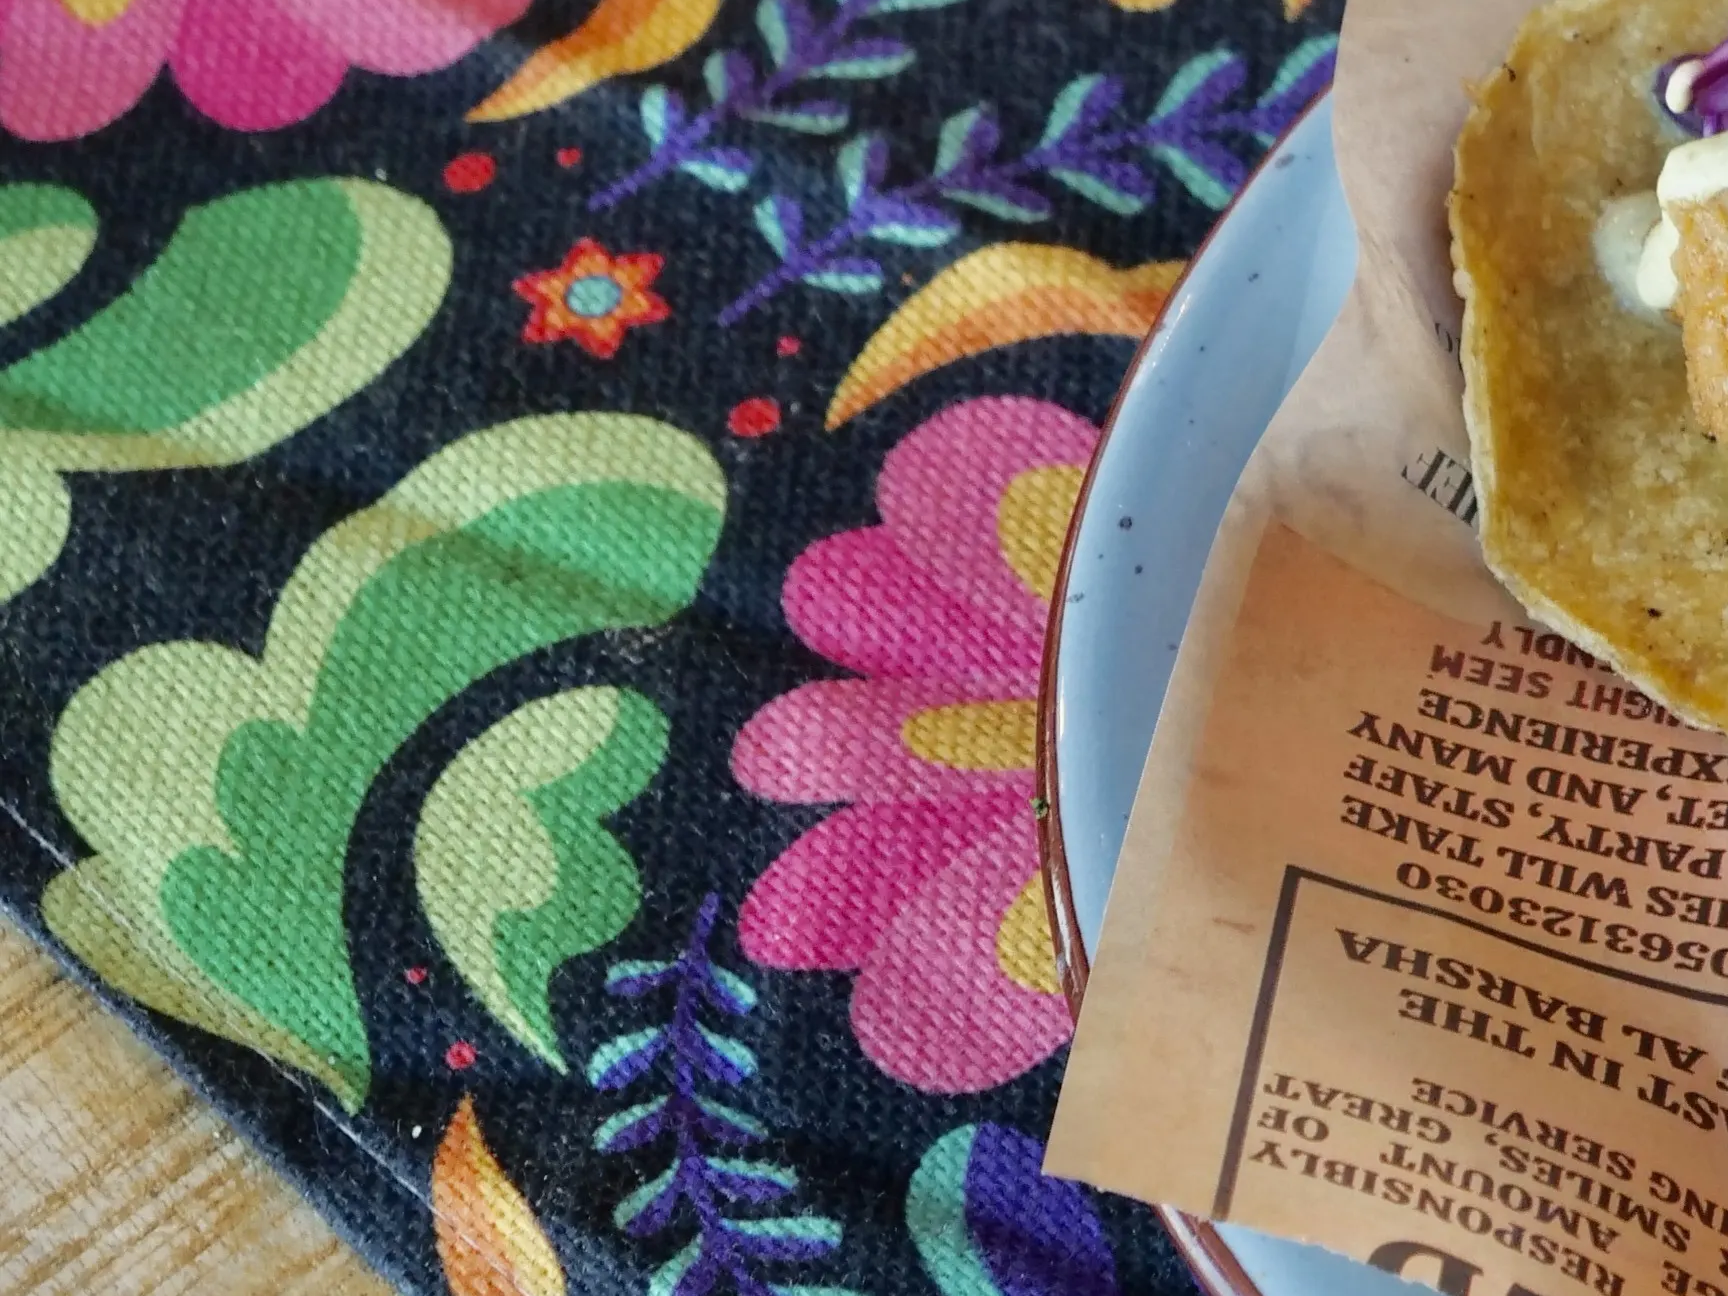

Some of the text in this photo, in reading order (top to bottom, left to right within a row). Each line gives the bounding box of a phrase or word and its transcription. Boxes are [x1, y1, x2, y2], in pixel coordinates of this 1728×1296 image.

[1427, 644, 1553, 700] SEEM
[1346, 711, 1518, 786] MANY
[1343, 754, 1515, 829] STAFF
[1526, 765, 1648, 816] AND
[1340, 794, 1485, 868] TAKE
[1527, 802, 1727, 880] PARTY,
[1496, 846, 1633, 910] WILL
[1334, 927, 1608, 1043] BARSHA
[1398, 988, 1536, 1059] THE
[1621, 1024, 1708, 1076] AL
[1548, 1040, 1624, 1091] IN
[1256, 1106, 1330, 1143] OF
[1263, 1072, 1452, 1144] GREAT
[1409, 1077, 1637, 1181] SERVICE
[1379, 1141, 1620, 1254] AMOUNT
[1484, 1131, 1691, 1254] SMILES,
